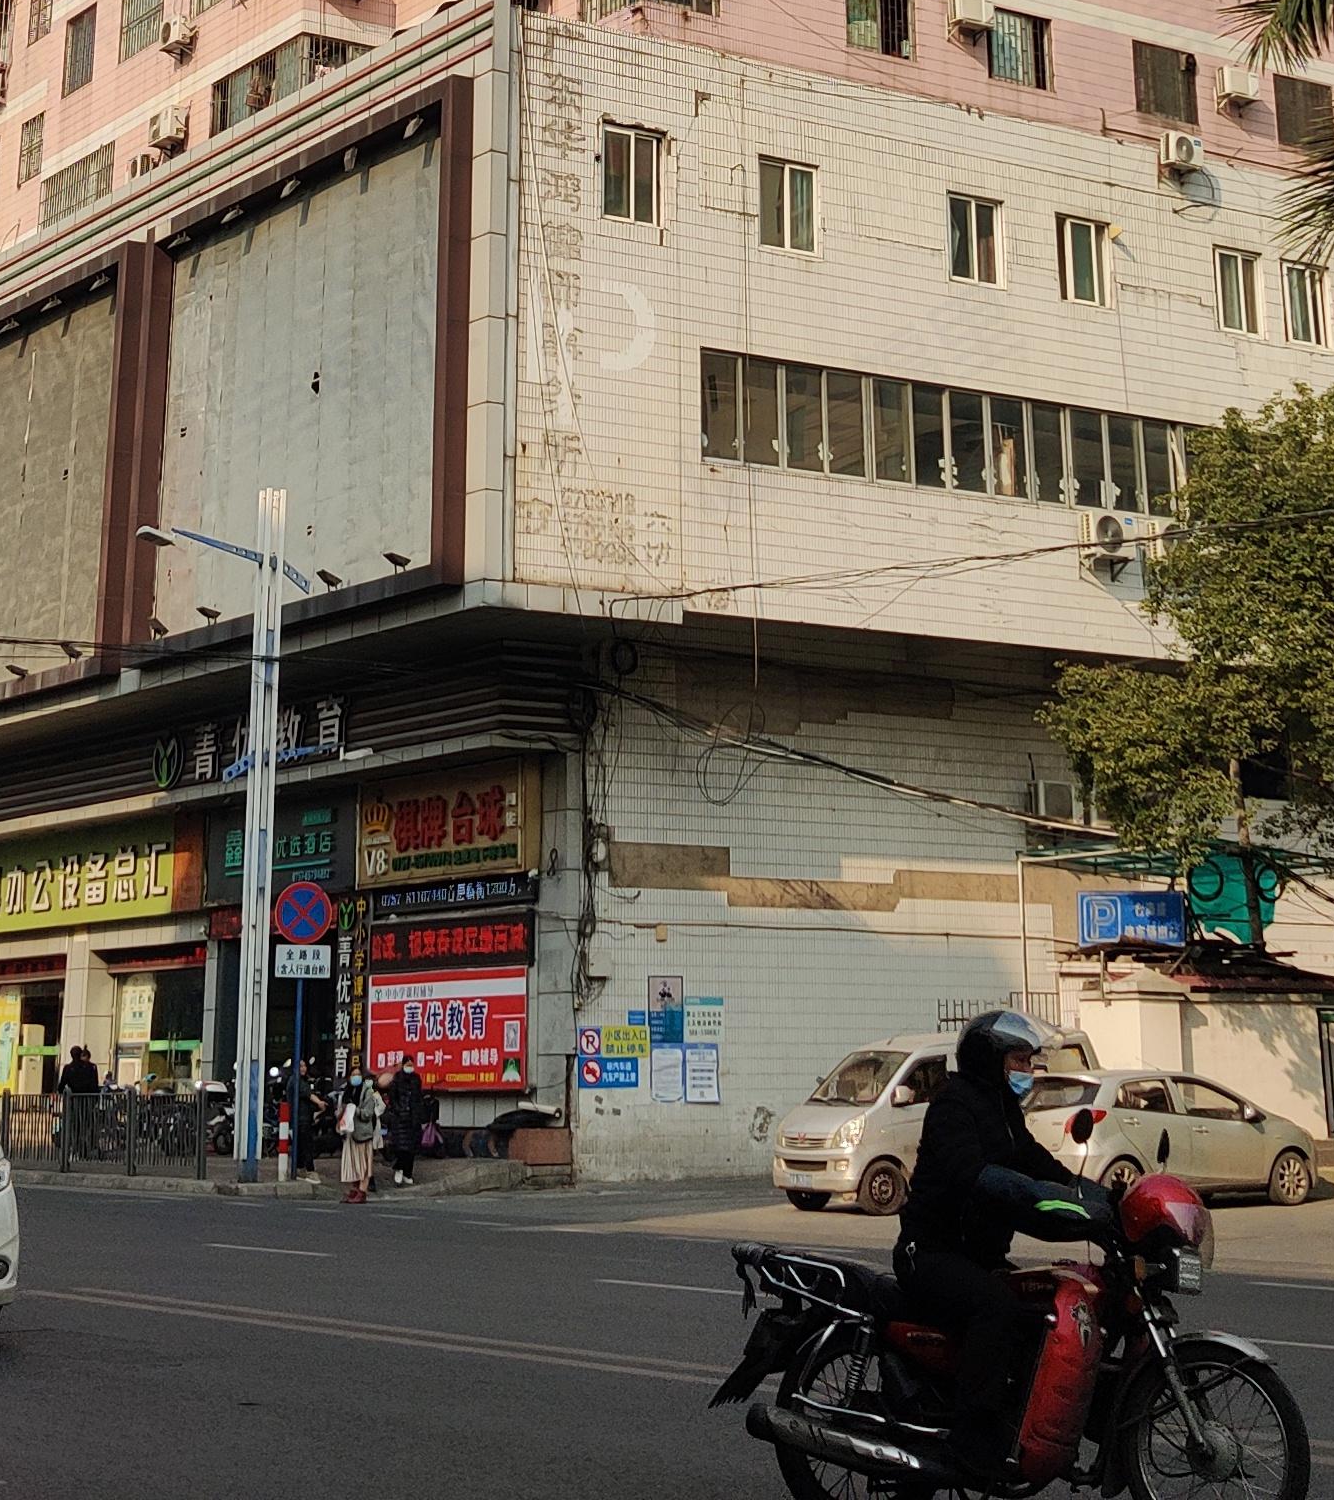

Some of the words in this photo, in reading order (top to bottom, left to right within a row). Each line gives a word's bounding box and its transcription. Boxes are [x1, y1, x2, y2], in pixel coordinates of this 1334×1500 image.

[392, 785, 506, 853] 棋牌台球
[275, 831, 332, 858] 优选酒店
[364, 848, 388, 878] V8
[285, 948, 321, 961] 全路段
[276, 963, 330, 976] (含人行道台阶)
[384, 985, 435, 1000] 中小学课程辅导
[334, 937, 353, 1078] 菁优教育
[403, 999, 489, 1043] 菁优教育
[604, 1029, 647, 1042] 小区出入口
[425, 1048, 453, 1066] 一对一
[605, 1043, 647, 1055] 禁止停车
